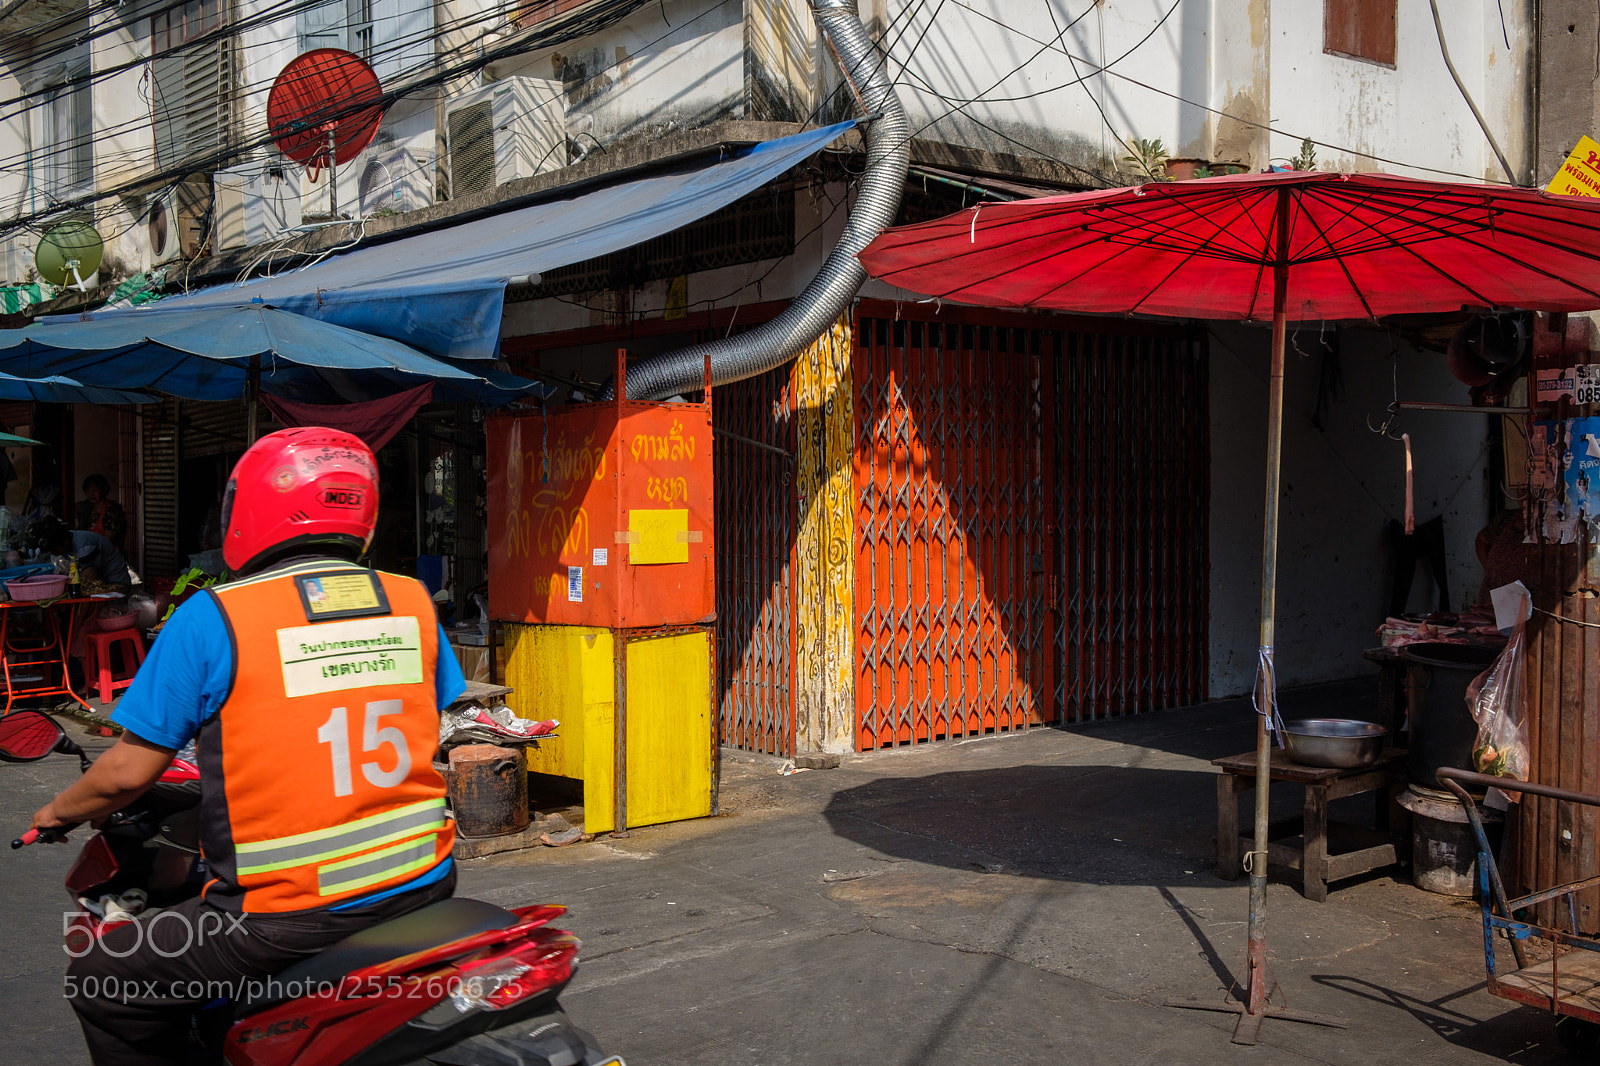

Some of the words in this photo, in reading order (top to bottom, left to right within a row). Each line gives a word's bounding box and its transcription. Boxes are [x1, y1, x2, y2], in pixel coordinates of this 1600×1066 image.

[630, 418, 696, 463] ตามสั่ง
[646, 476, 688, 508] หยุด
[321, 653, 396, 678] เขตบางรัก
[317, 699, 412, 798] 15
